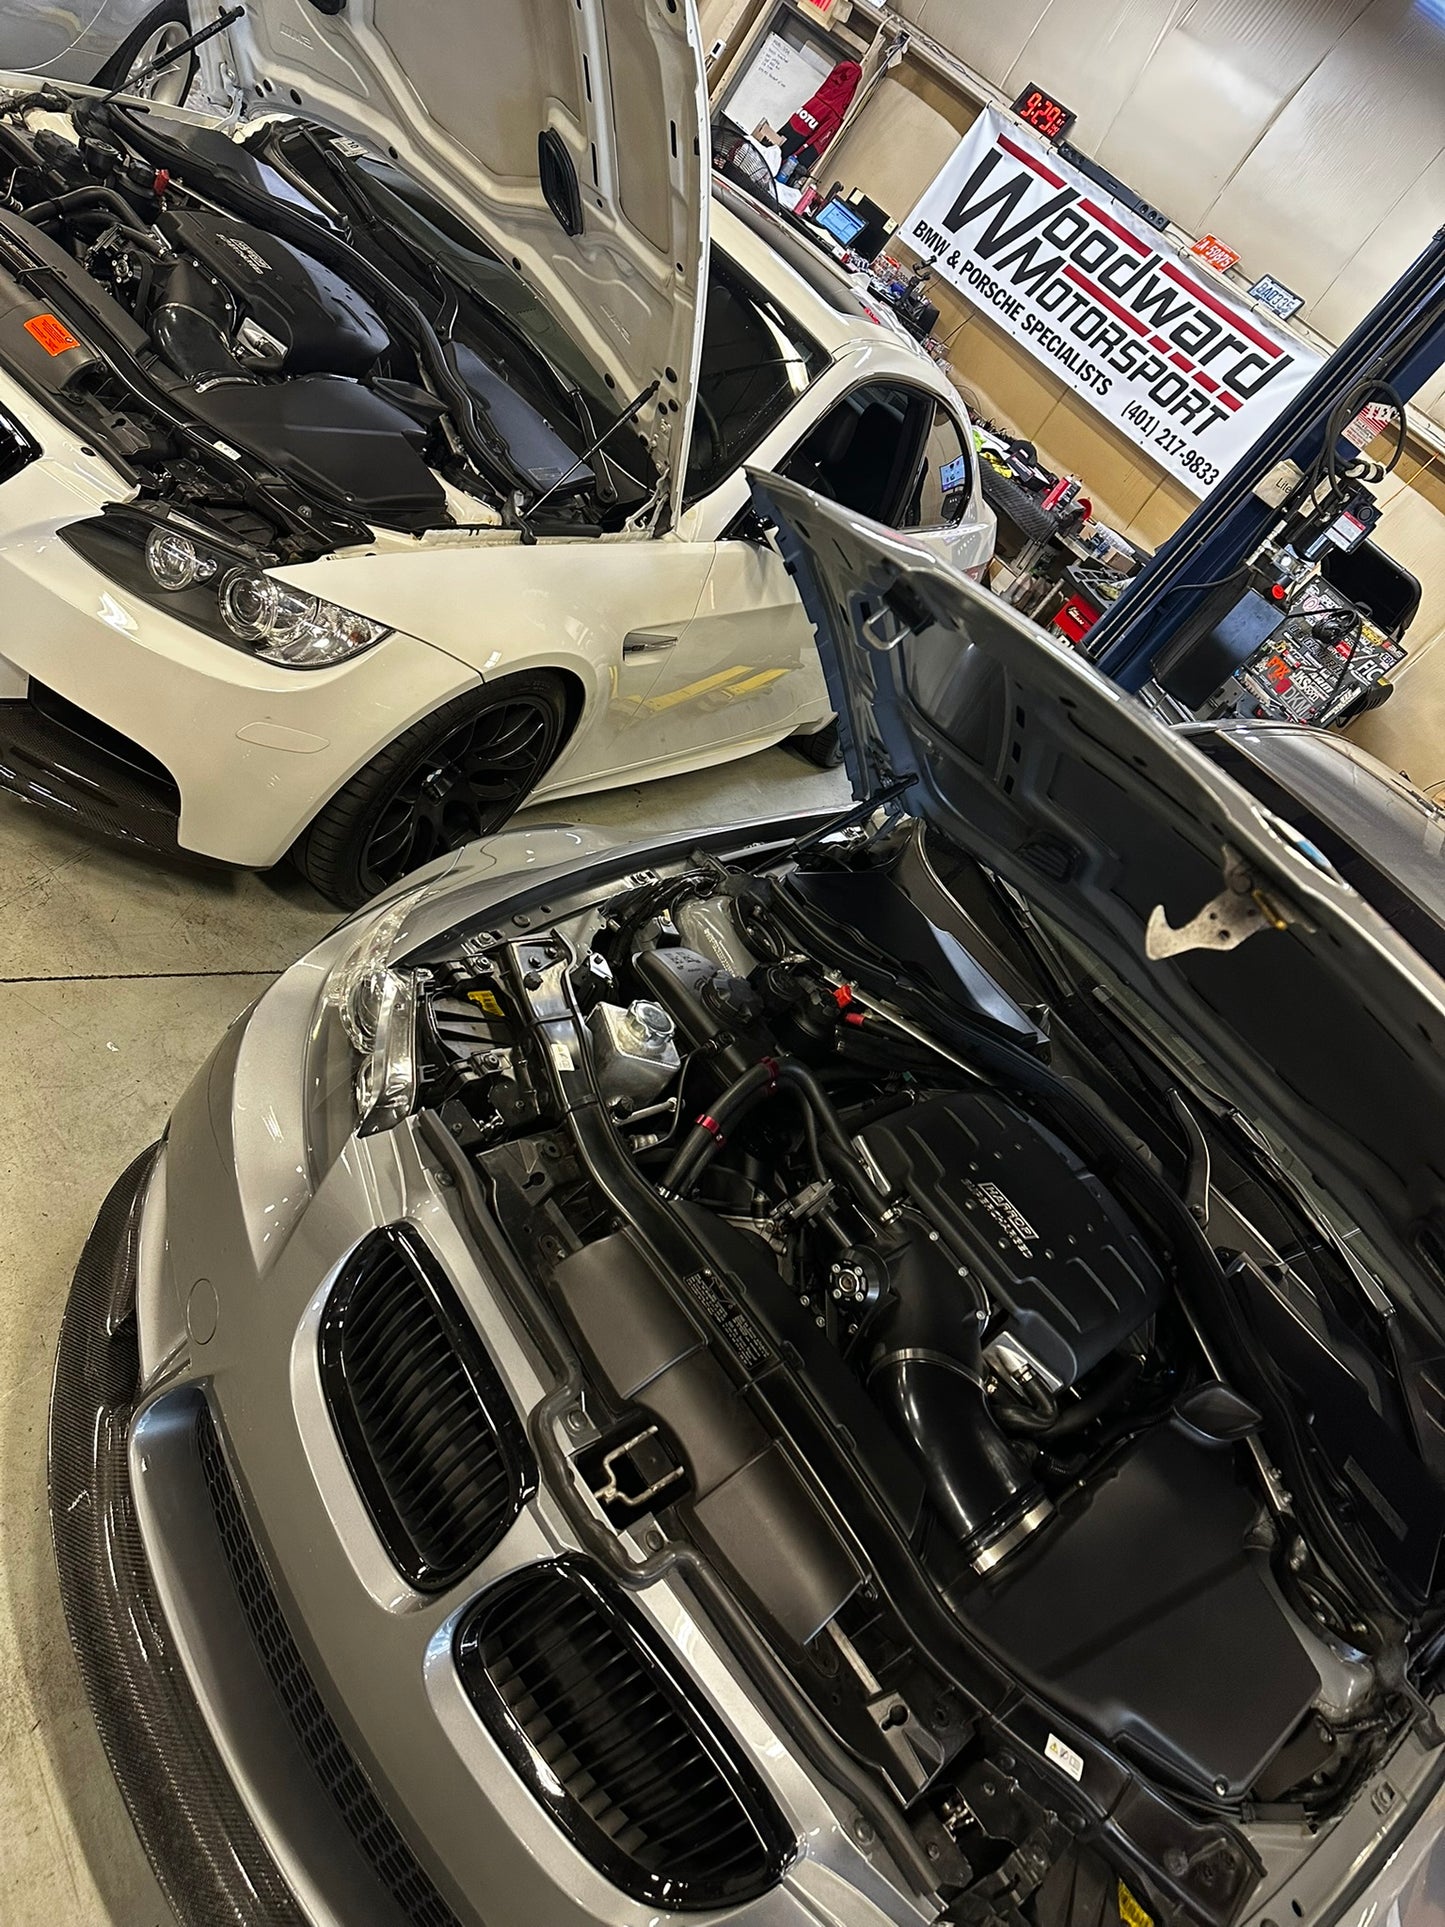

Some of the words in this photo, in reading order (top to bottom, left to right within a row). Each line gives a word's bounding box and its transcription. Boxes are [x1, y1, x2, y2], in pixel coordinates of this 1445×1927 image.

[1020, 92, 1061, 131] 9:29
[912, 220, 951, 257] BMW
[946, 250, 962, 269] &
[959, 260, 1025, 321] PORSCHE
[1021, 313, 1113, 396] SPECIALISTS
[1121, 400, 1160, 437] (401)
[1154, 428, 1219, 485] 217-9833
[942, 148, 1294, 400] Woodward
[992, 236, 1230, 437] MOTORSPORT
[1281, 686, 1311, 717] DKM
